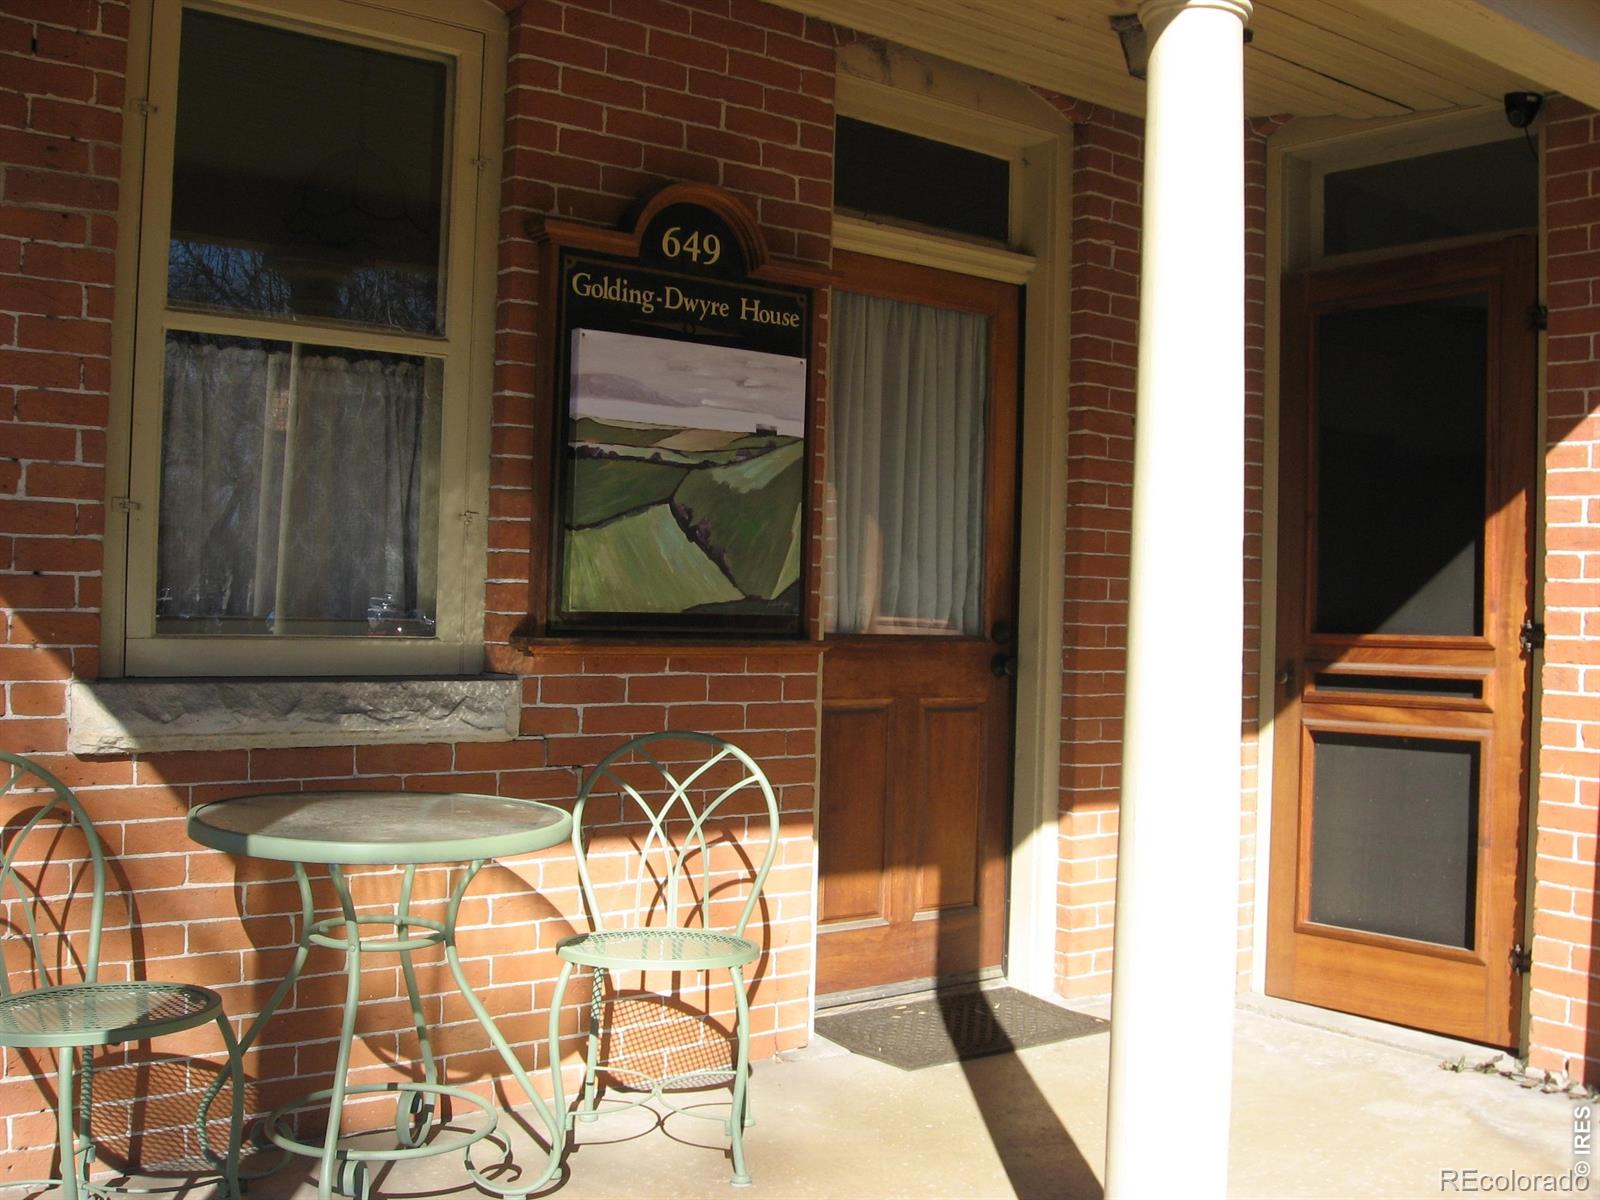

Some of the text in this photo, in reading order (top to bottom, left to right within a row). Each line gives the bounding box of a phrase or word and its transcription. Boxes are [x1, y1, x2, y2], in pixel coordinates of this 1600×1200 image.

[661, 226, 721, 265] 649
[571, 272, 800, 328] Golding-Dwyre House
